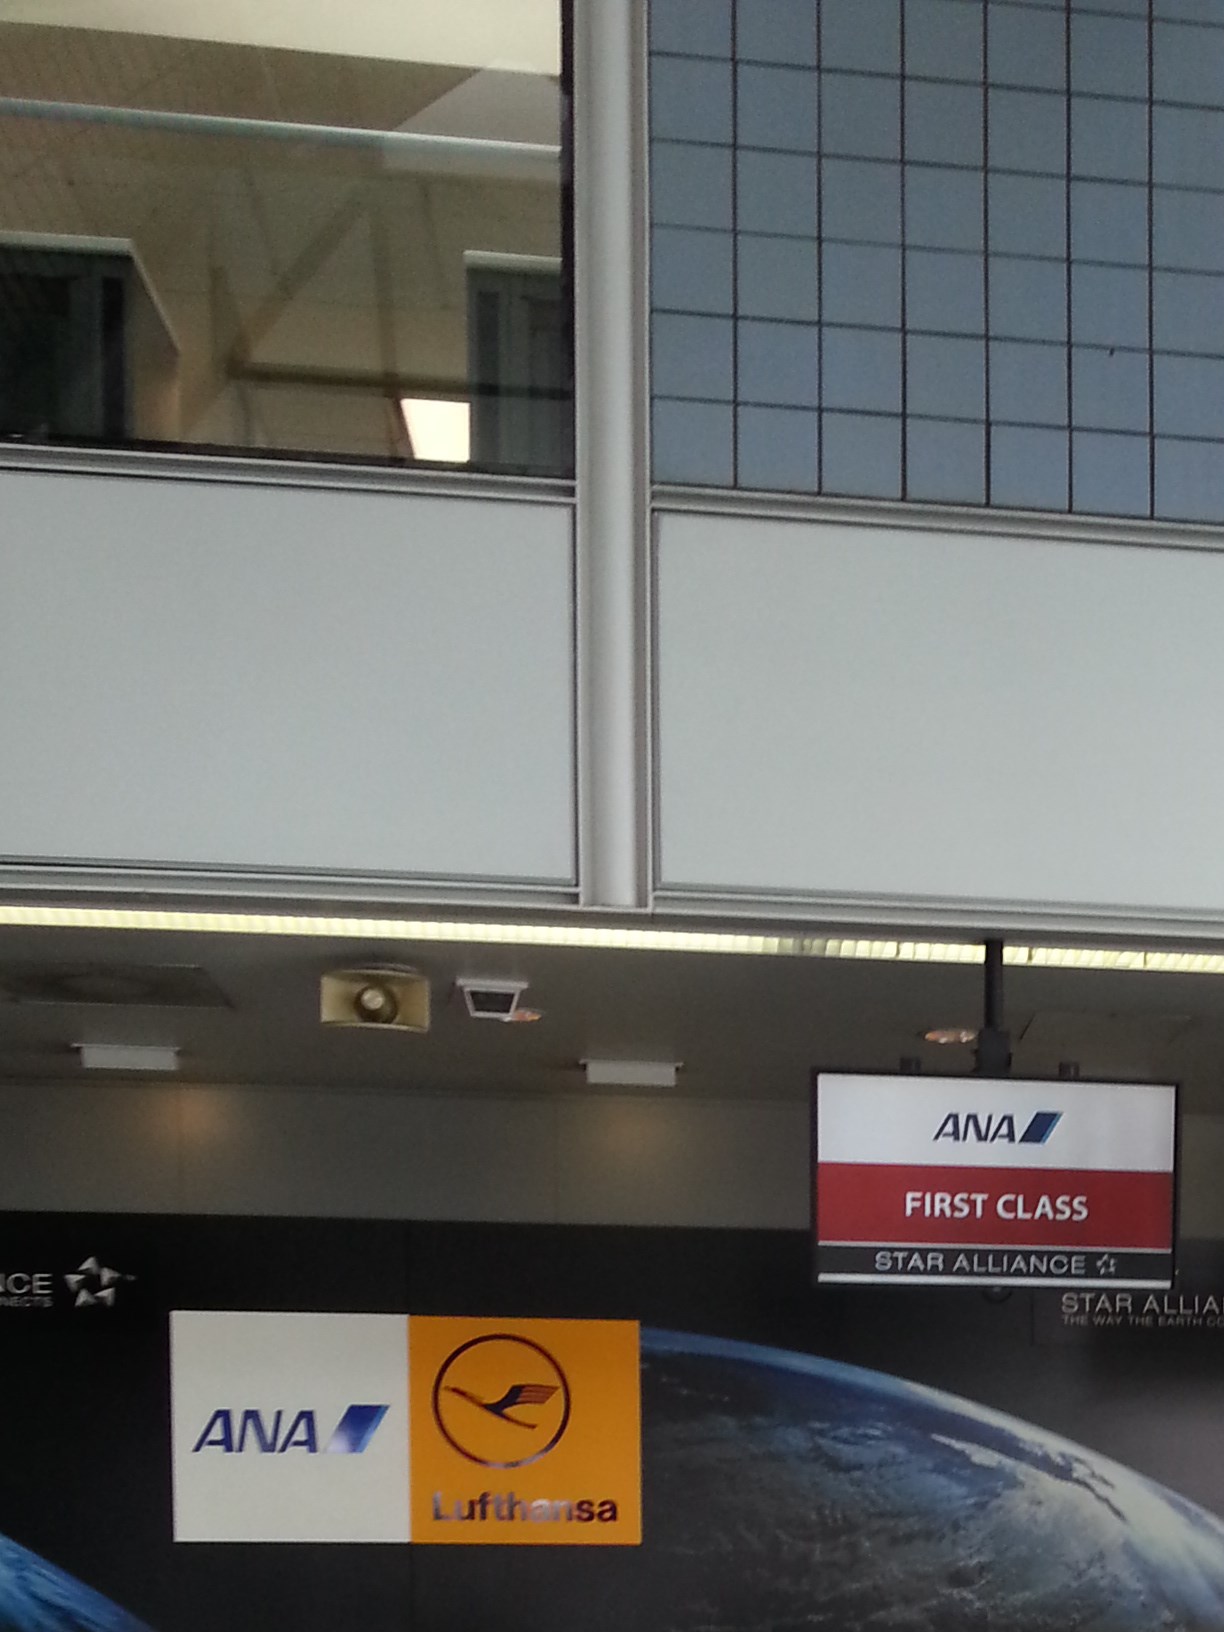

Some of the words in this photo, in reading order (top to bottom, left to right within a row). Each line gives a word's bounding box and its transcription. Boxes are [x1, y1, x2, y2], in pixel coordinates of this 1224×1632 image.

[933, 1112, 1016, 1143] ANA
[904, 1191, 988, 1218] FIRST
[996, 1194, 1089, 1221] CLASS
[875, 1251, 944, 1272] STAR
[953, 1252, 1086, 1275] ALLIANCE
[1061, 1292, 1132, 1314] STAR
[1062, 1316, 1088, 1326] THE
[1092, 1316, 1122, 1327] WAY
[1129, 1316, 1154, 1327] THE
[1158, 1317, 1203, 1327] EARTH
[192, 1409, 318, 1454] ANA
[431, 1490, 619, 1523] Lufthansa
